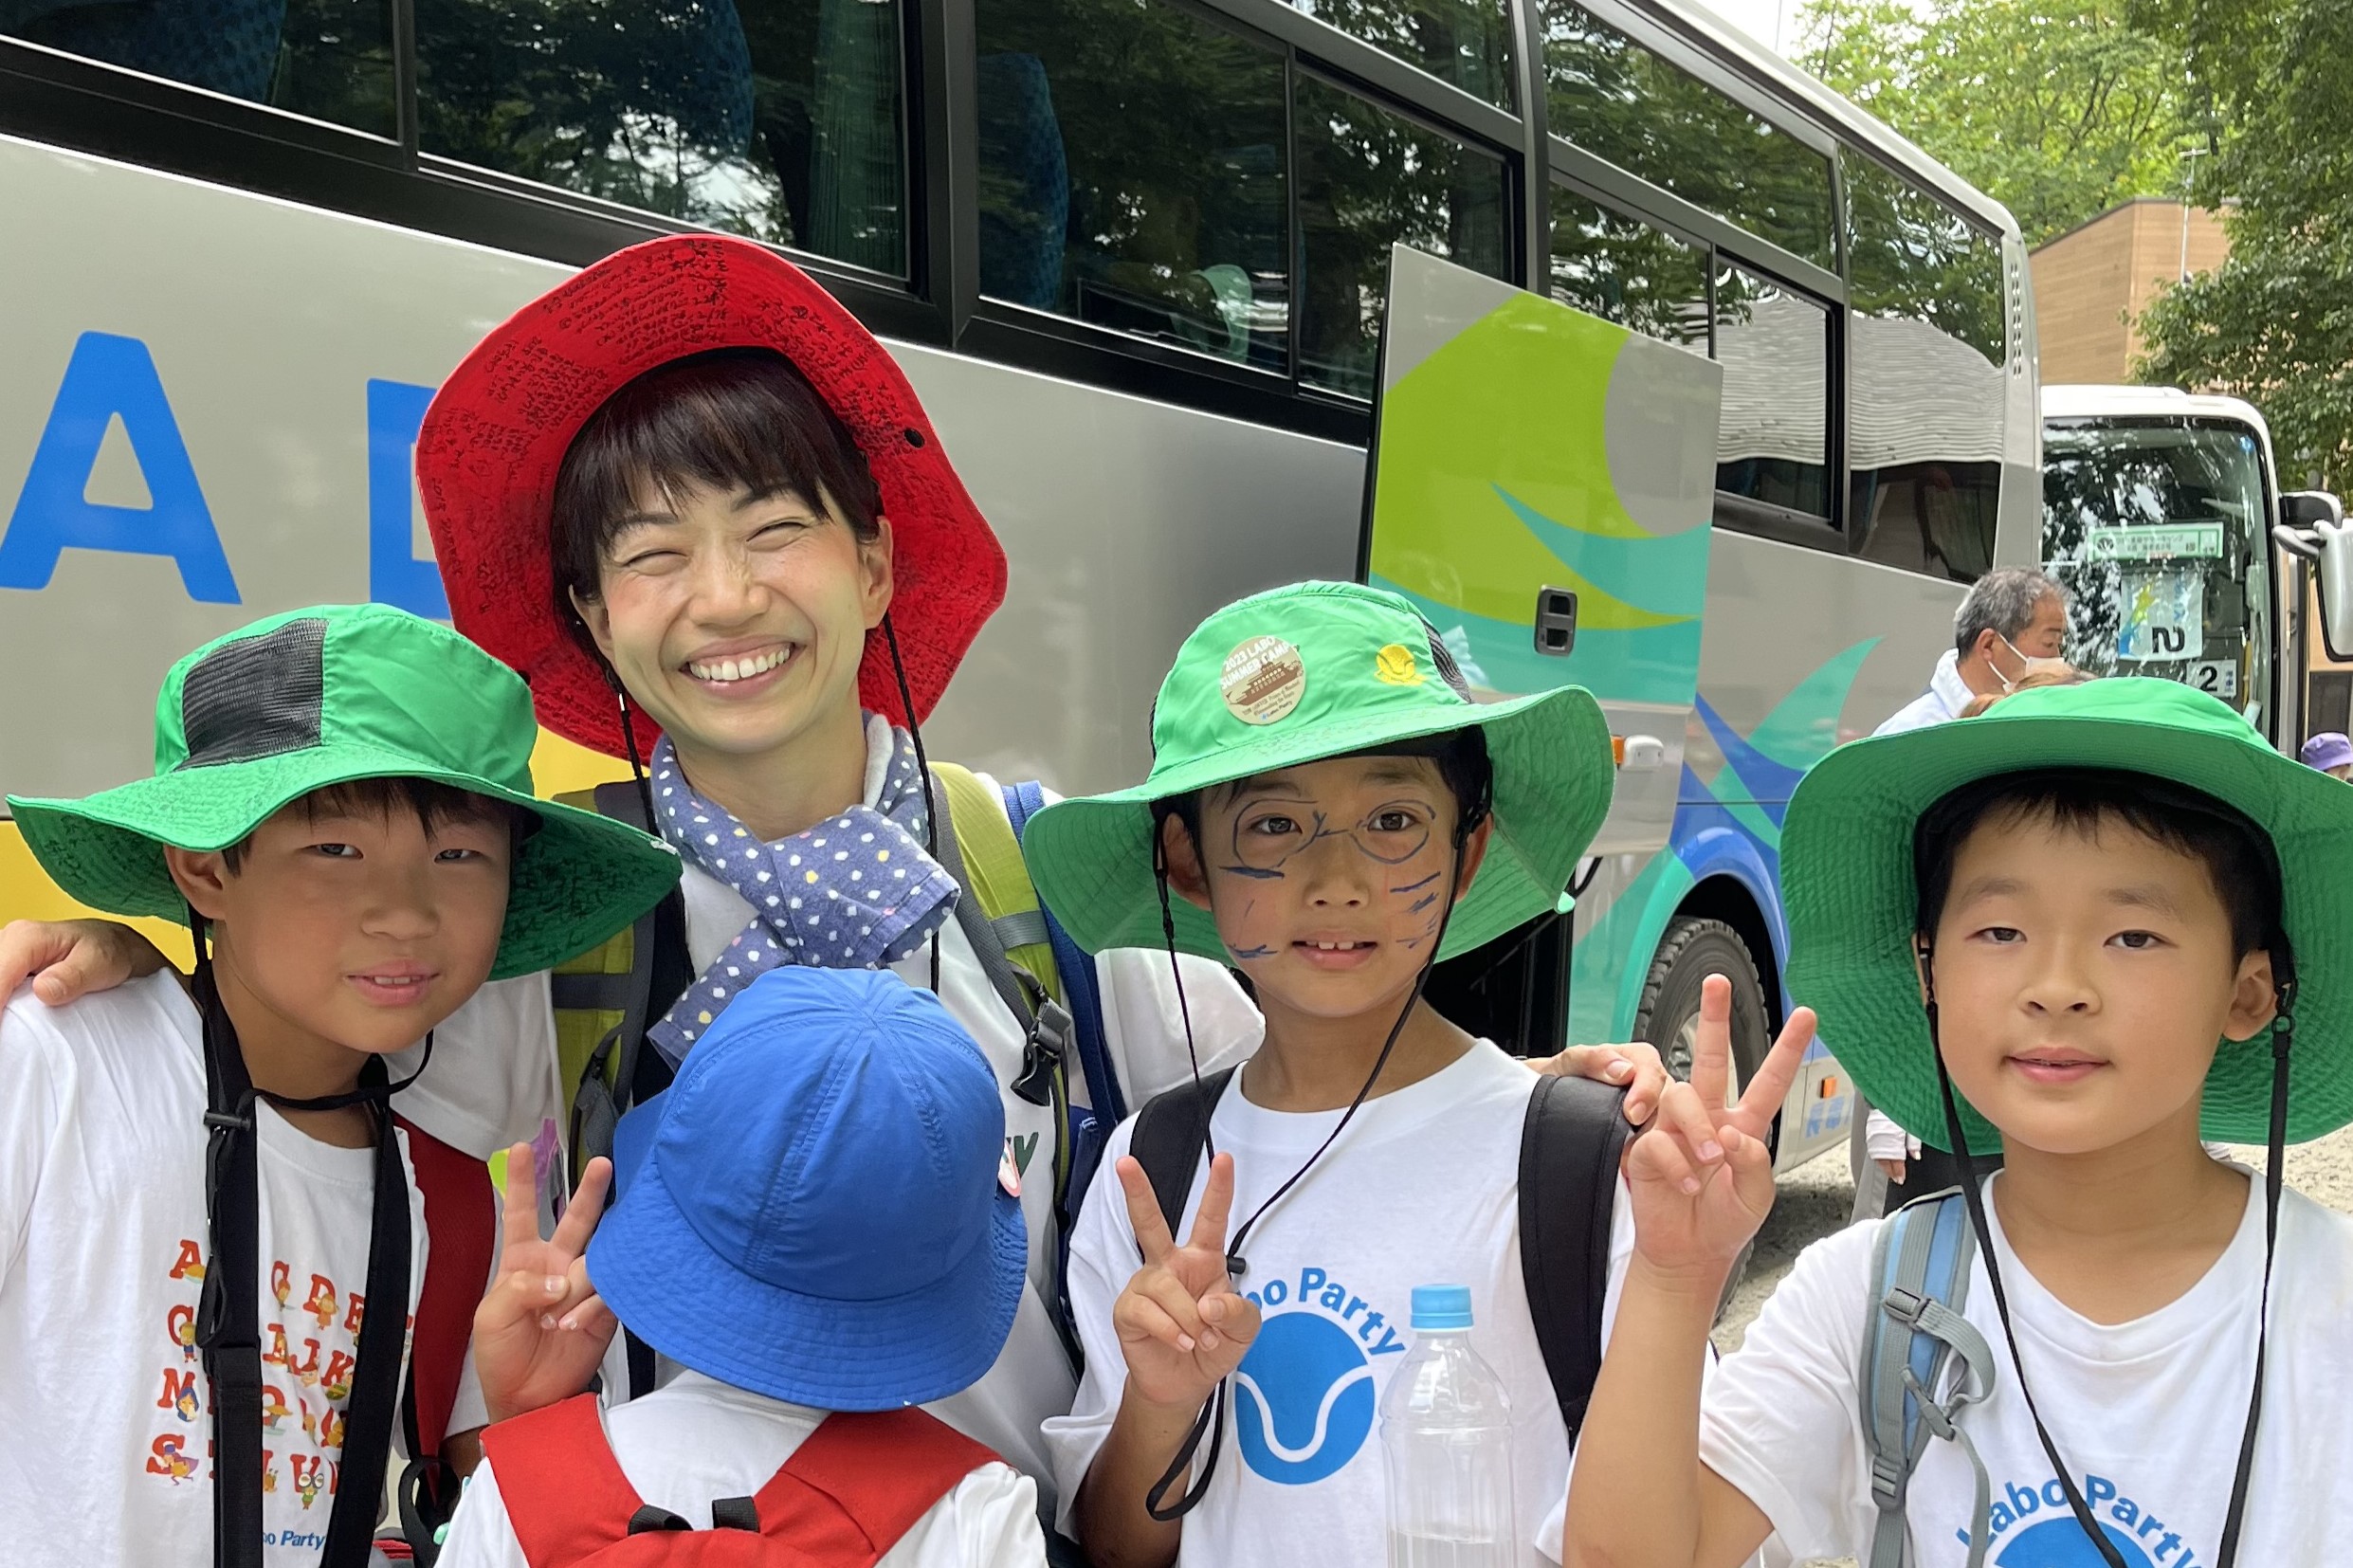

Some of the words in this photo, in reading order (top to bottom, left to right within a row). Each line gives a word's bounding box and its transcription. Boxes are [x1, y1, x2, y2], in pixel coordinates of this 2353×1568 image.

[1220, 658, 1263, 690] SUMMER
[1261, 641, 1291, 665] CAMP
[1225, 650, 1249, 672] 2023
[1246, 635, 1276, 658] LABO
[2198, 665, 2218, 692] 2
[1298, 1267, 1407, 1357] Party
[280, 1529, 327, 1551] Party
